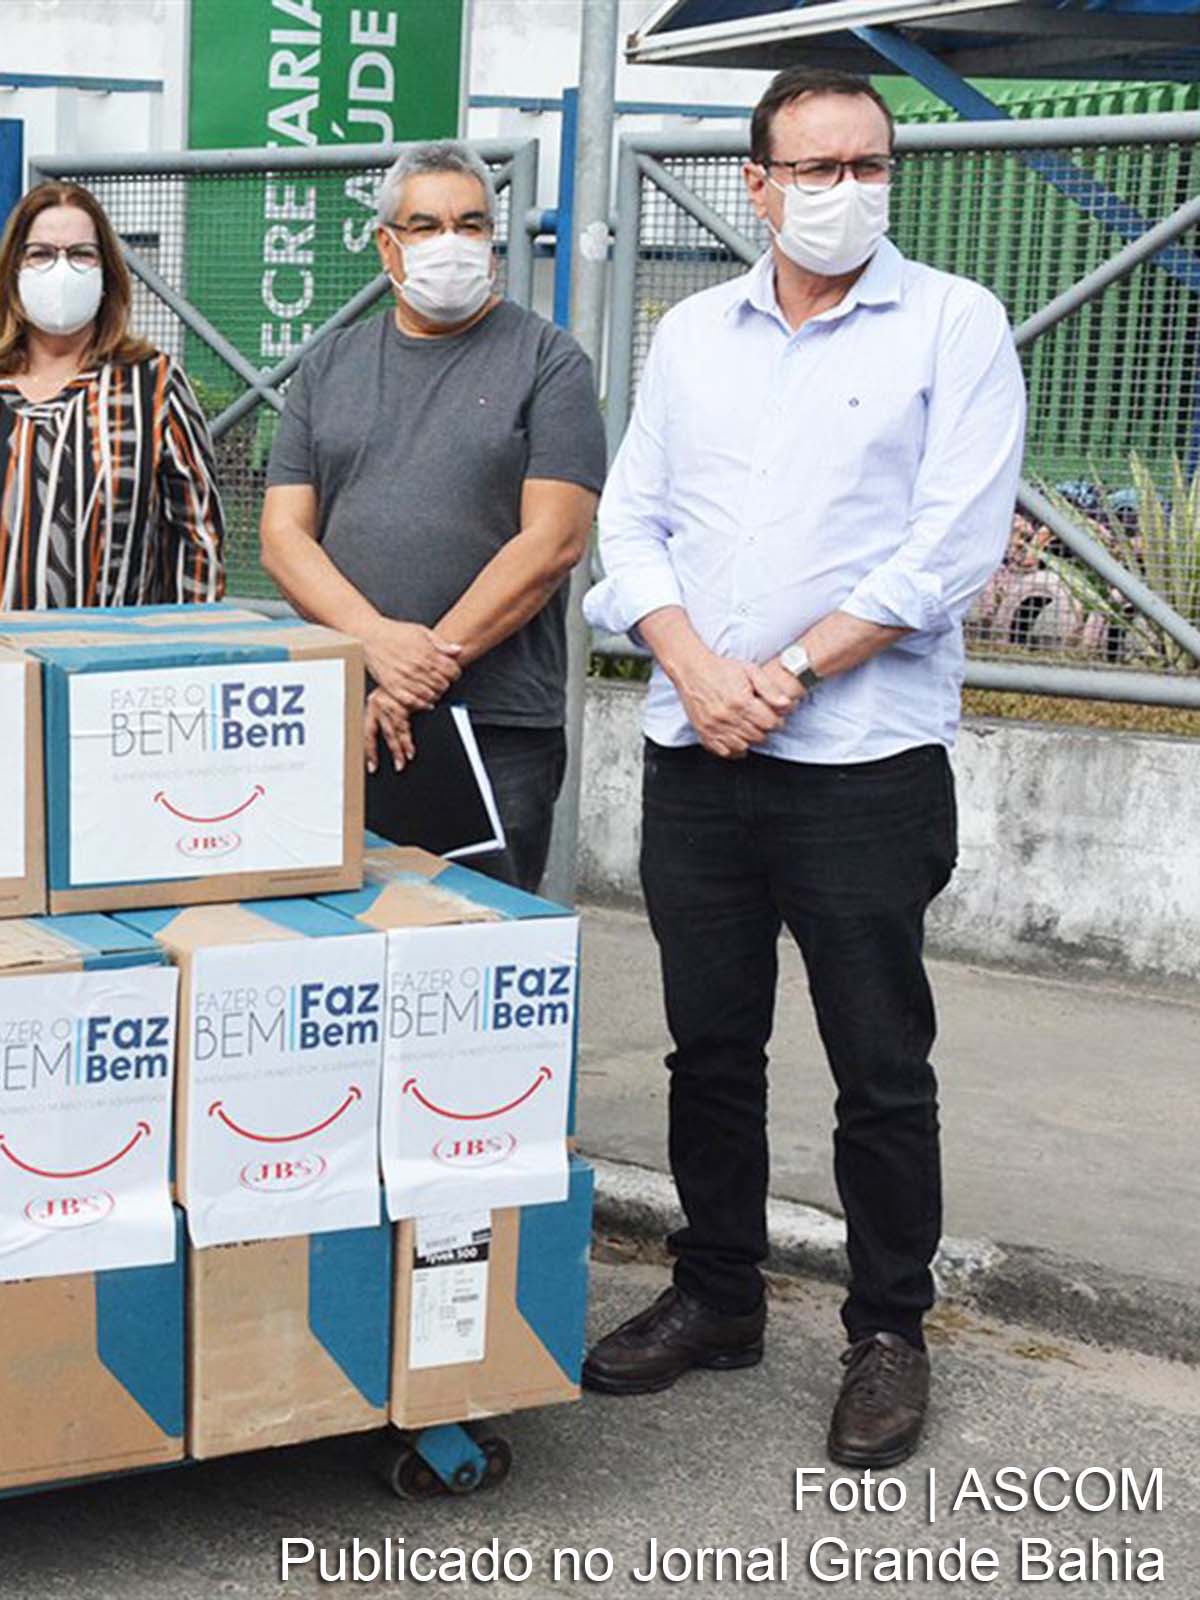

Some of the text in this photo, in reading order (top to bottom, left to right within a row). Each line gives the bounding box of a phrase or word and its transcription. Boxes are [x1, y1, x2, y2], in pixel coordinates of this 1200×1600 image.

[331, 10, 397, 252] SAÚDE
[261, 0, 321, 393] ECREARI
[111, 683, 205, 710] FAZER O
[221, 683, 305, 719] Faz
[111, 708, 206, 757] BEM
[222, 720, 306, 750] Bem
[392, 966, 480, 992] FAZER O
[494, 965, 570, 1000] Faz
[196, 985, 286, 1013] FAZER O
[300, 982, 379, 1019] Faz
[390, 990, 479, 1039] BEM
[49, 1018, 72, 1042] O
[492, 1001, 568, 1030] Bem
[87, 1015, 169, 1051] Faz
[195, 1009, 286, 1061] BEM
[299, 1019, 378, 1050] Bem
[86, 1052, 168, 1084] Bem
[445, 1138, 503, 1158] JBS
[253, 1161, 311, 1182] JBS
[40, 1198, 99, 1219] JBS
